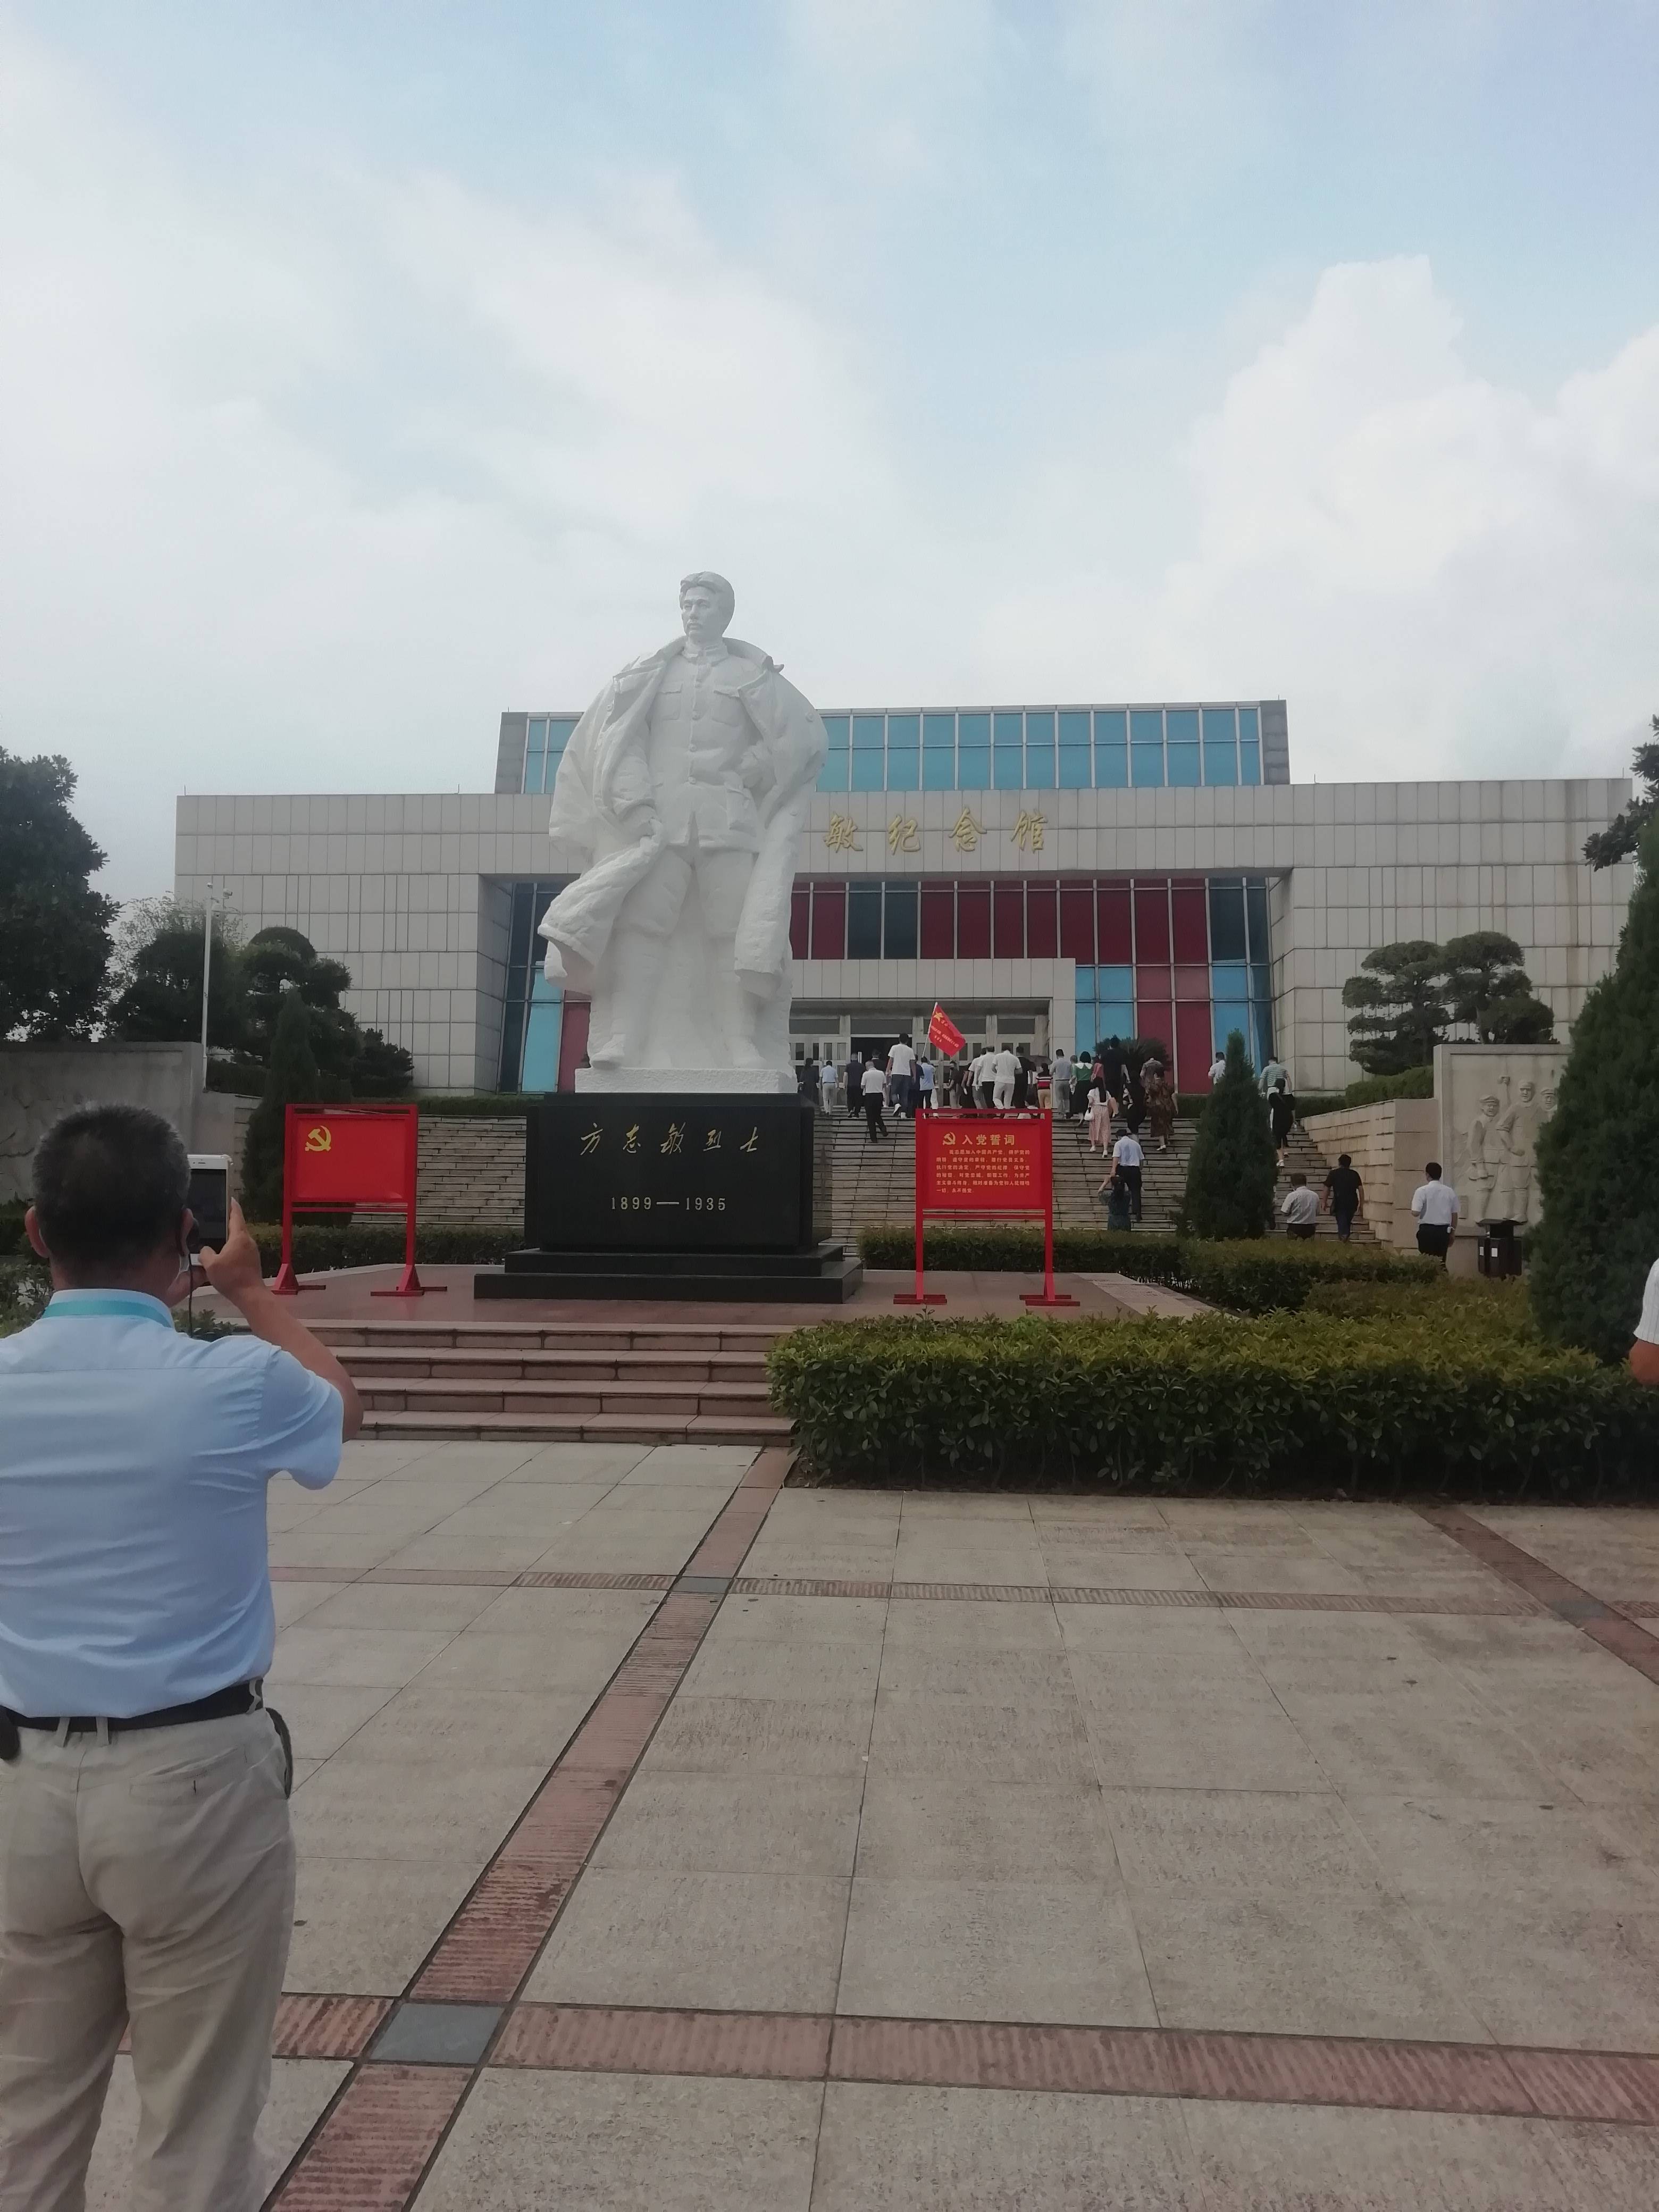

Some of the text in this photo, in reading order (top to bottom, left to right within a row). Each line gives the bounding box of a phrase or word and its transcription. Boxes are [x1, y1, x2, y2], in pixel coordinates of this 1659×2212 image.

[823, 805, 1049, 854] 敏纪念馆
[580, 1122, 759, 1155] 方志敏烈士
[961, 1134, 1015, 1145] 入党誓词
[611, 1196, 726, 1211] 1899—1935
